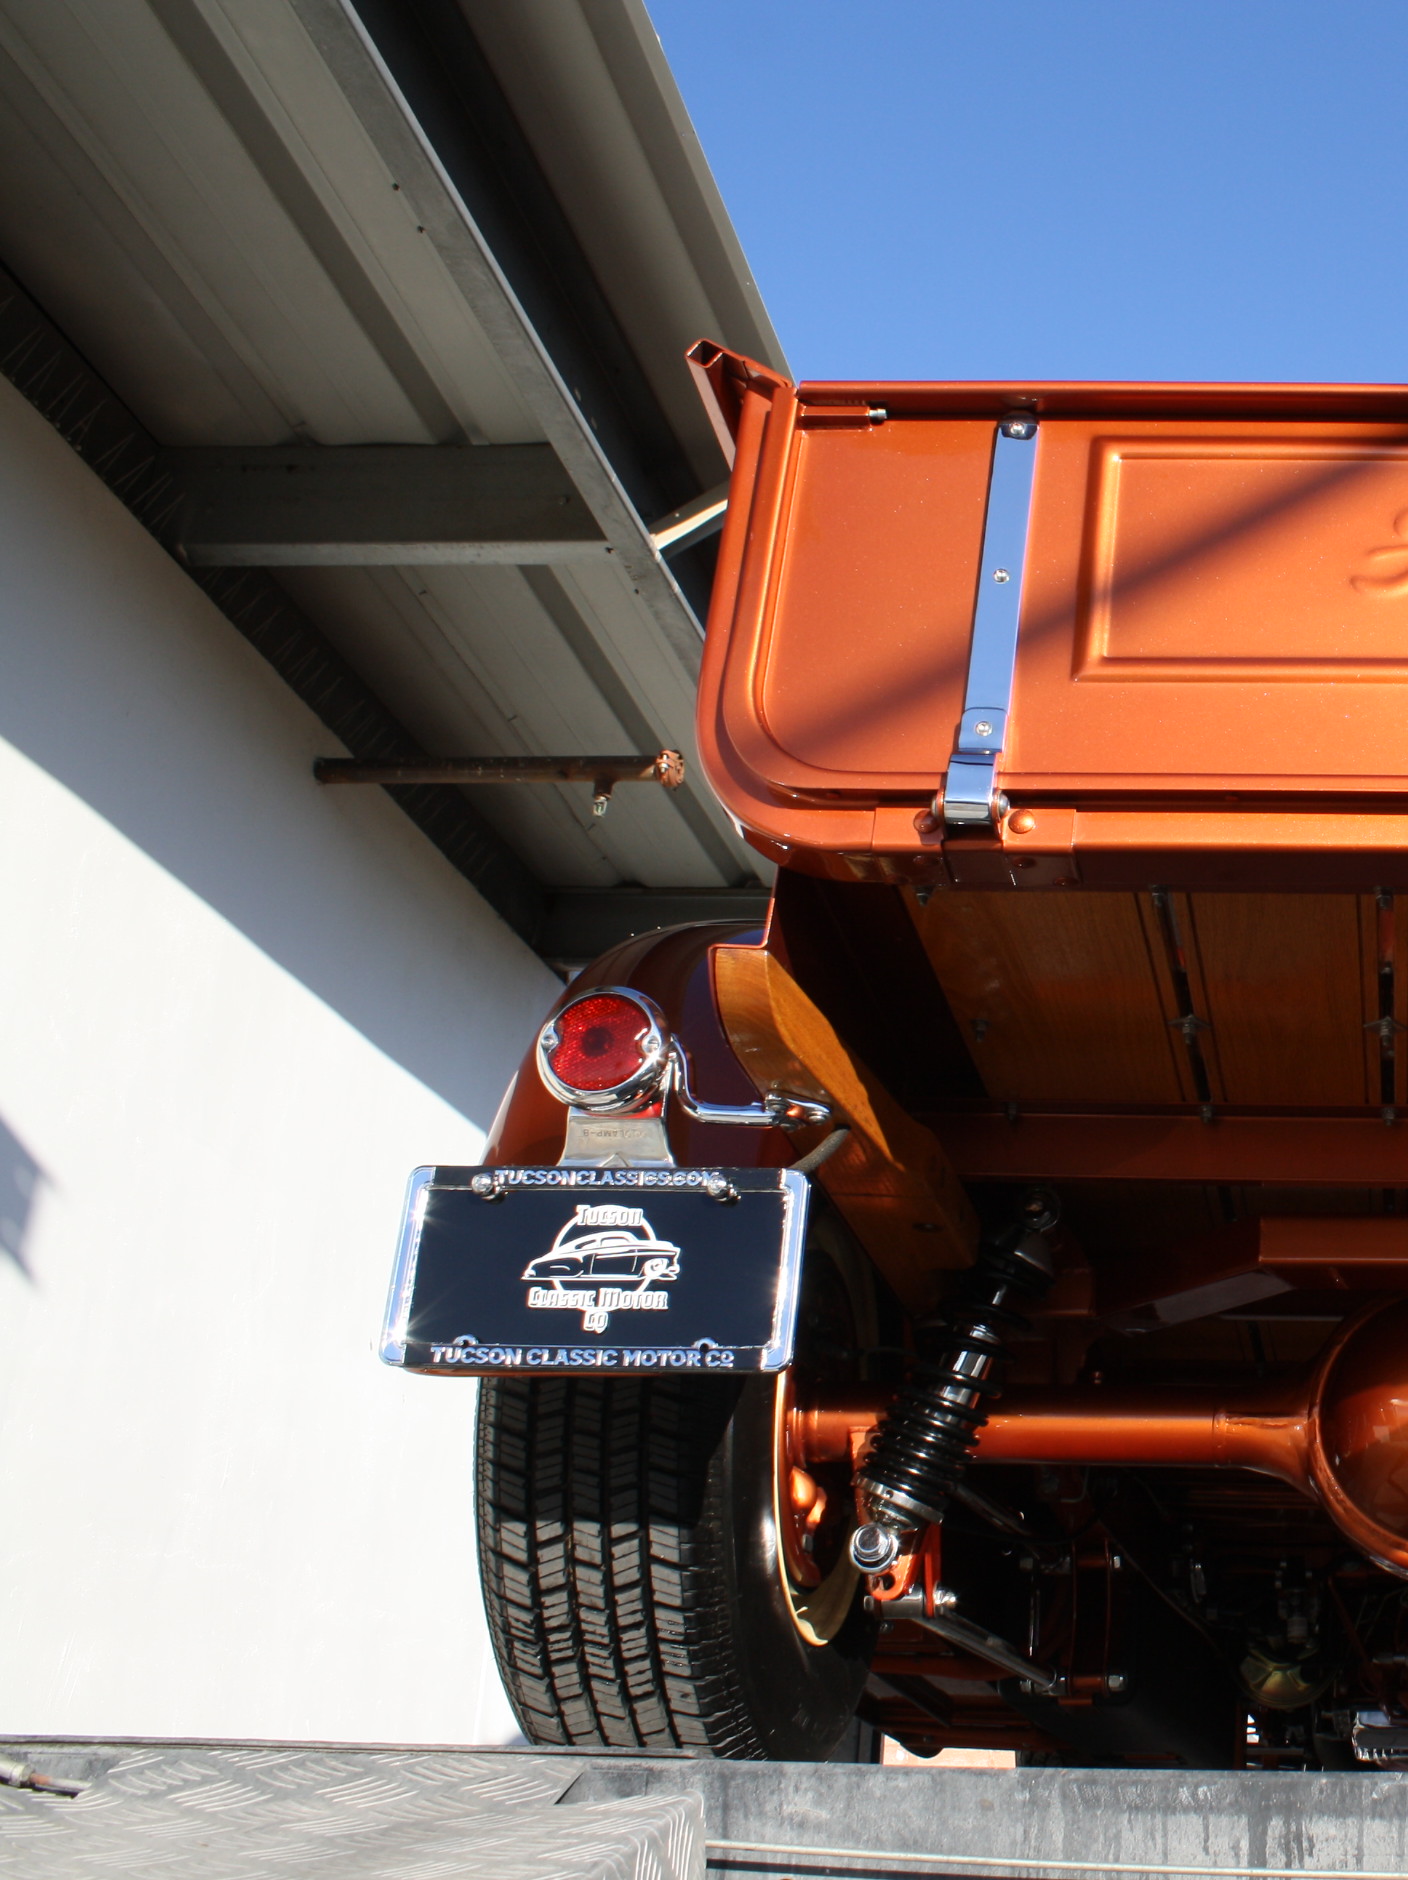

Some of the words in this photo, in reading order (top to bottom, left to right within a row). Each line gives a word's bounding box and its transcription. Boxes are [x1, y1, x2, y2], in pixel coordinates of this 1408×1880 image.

[431, 1346, 521, 1365] TUCSON
[526, 1347, 618, 1367] CLASSIC
[622, 1349, 700, 1368] MOTOR
